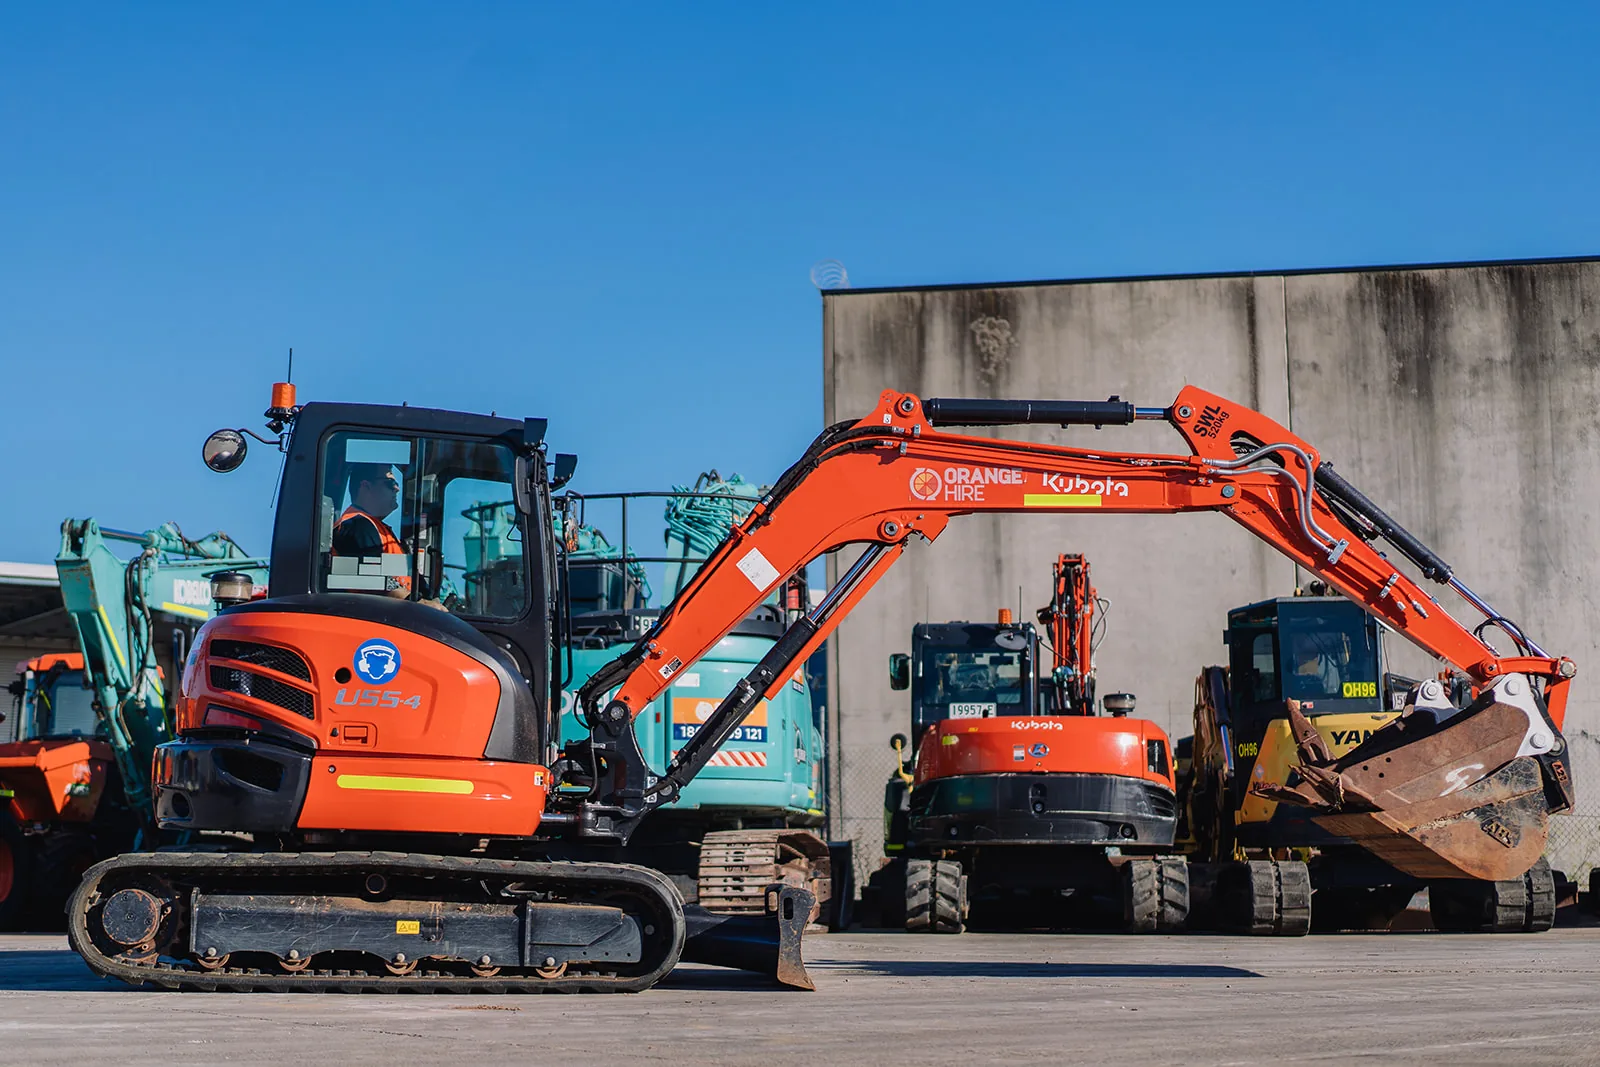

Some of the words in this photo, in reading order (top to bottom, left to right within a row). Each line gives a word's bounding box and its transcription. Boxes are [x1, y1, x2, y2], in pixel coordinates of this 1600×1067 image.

[1193, 405, 1221, 437] SWL
[1208, 411, 1230, 439] 520kg
[944, 468, 1023, 484] ORANGE
[1042, 472, 1129, 497] Kubota
[945, 485, 985, 501] HIRE
[1343, 683, 1376, 697] OH96
[1011, 721, 1063, 730] Kubota
[745, 728, 762, 740] 121
[1239, 744, 1258, 757] OH96
